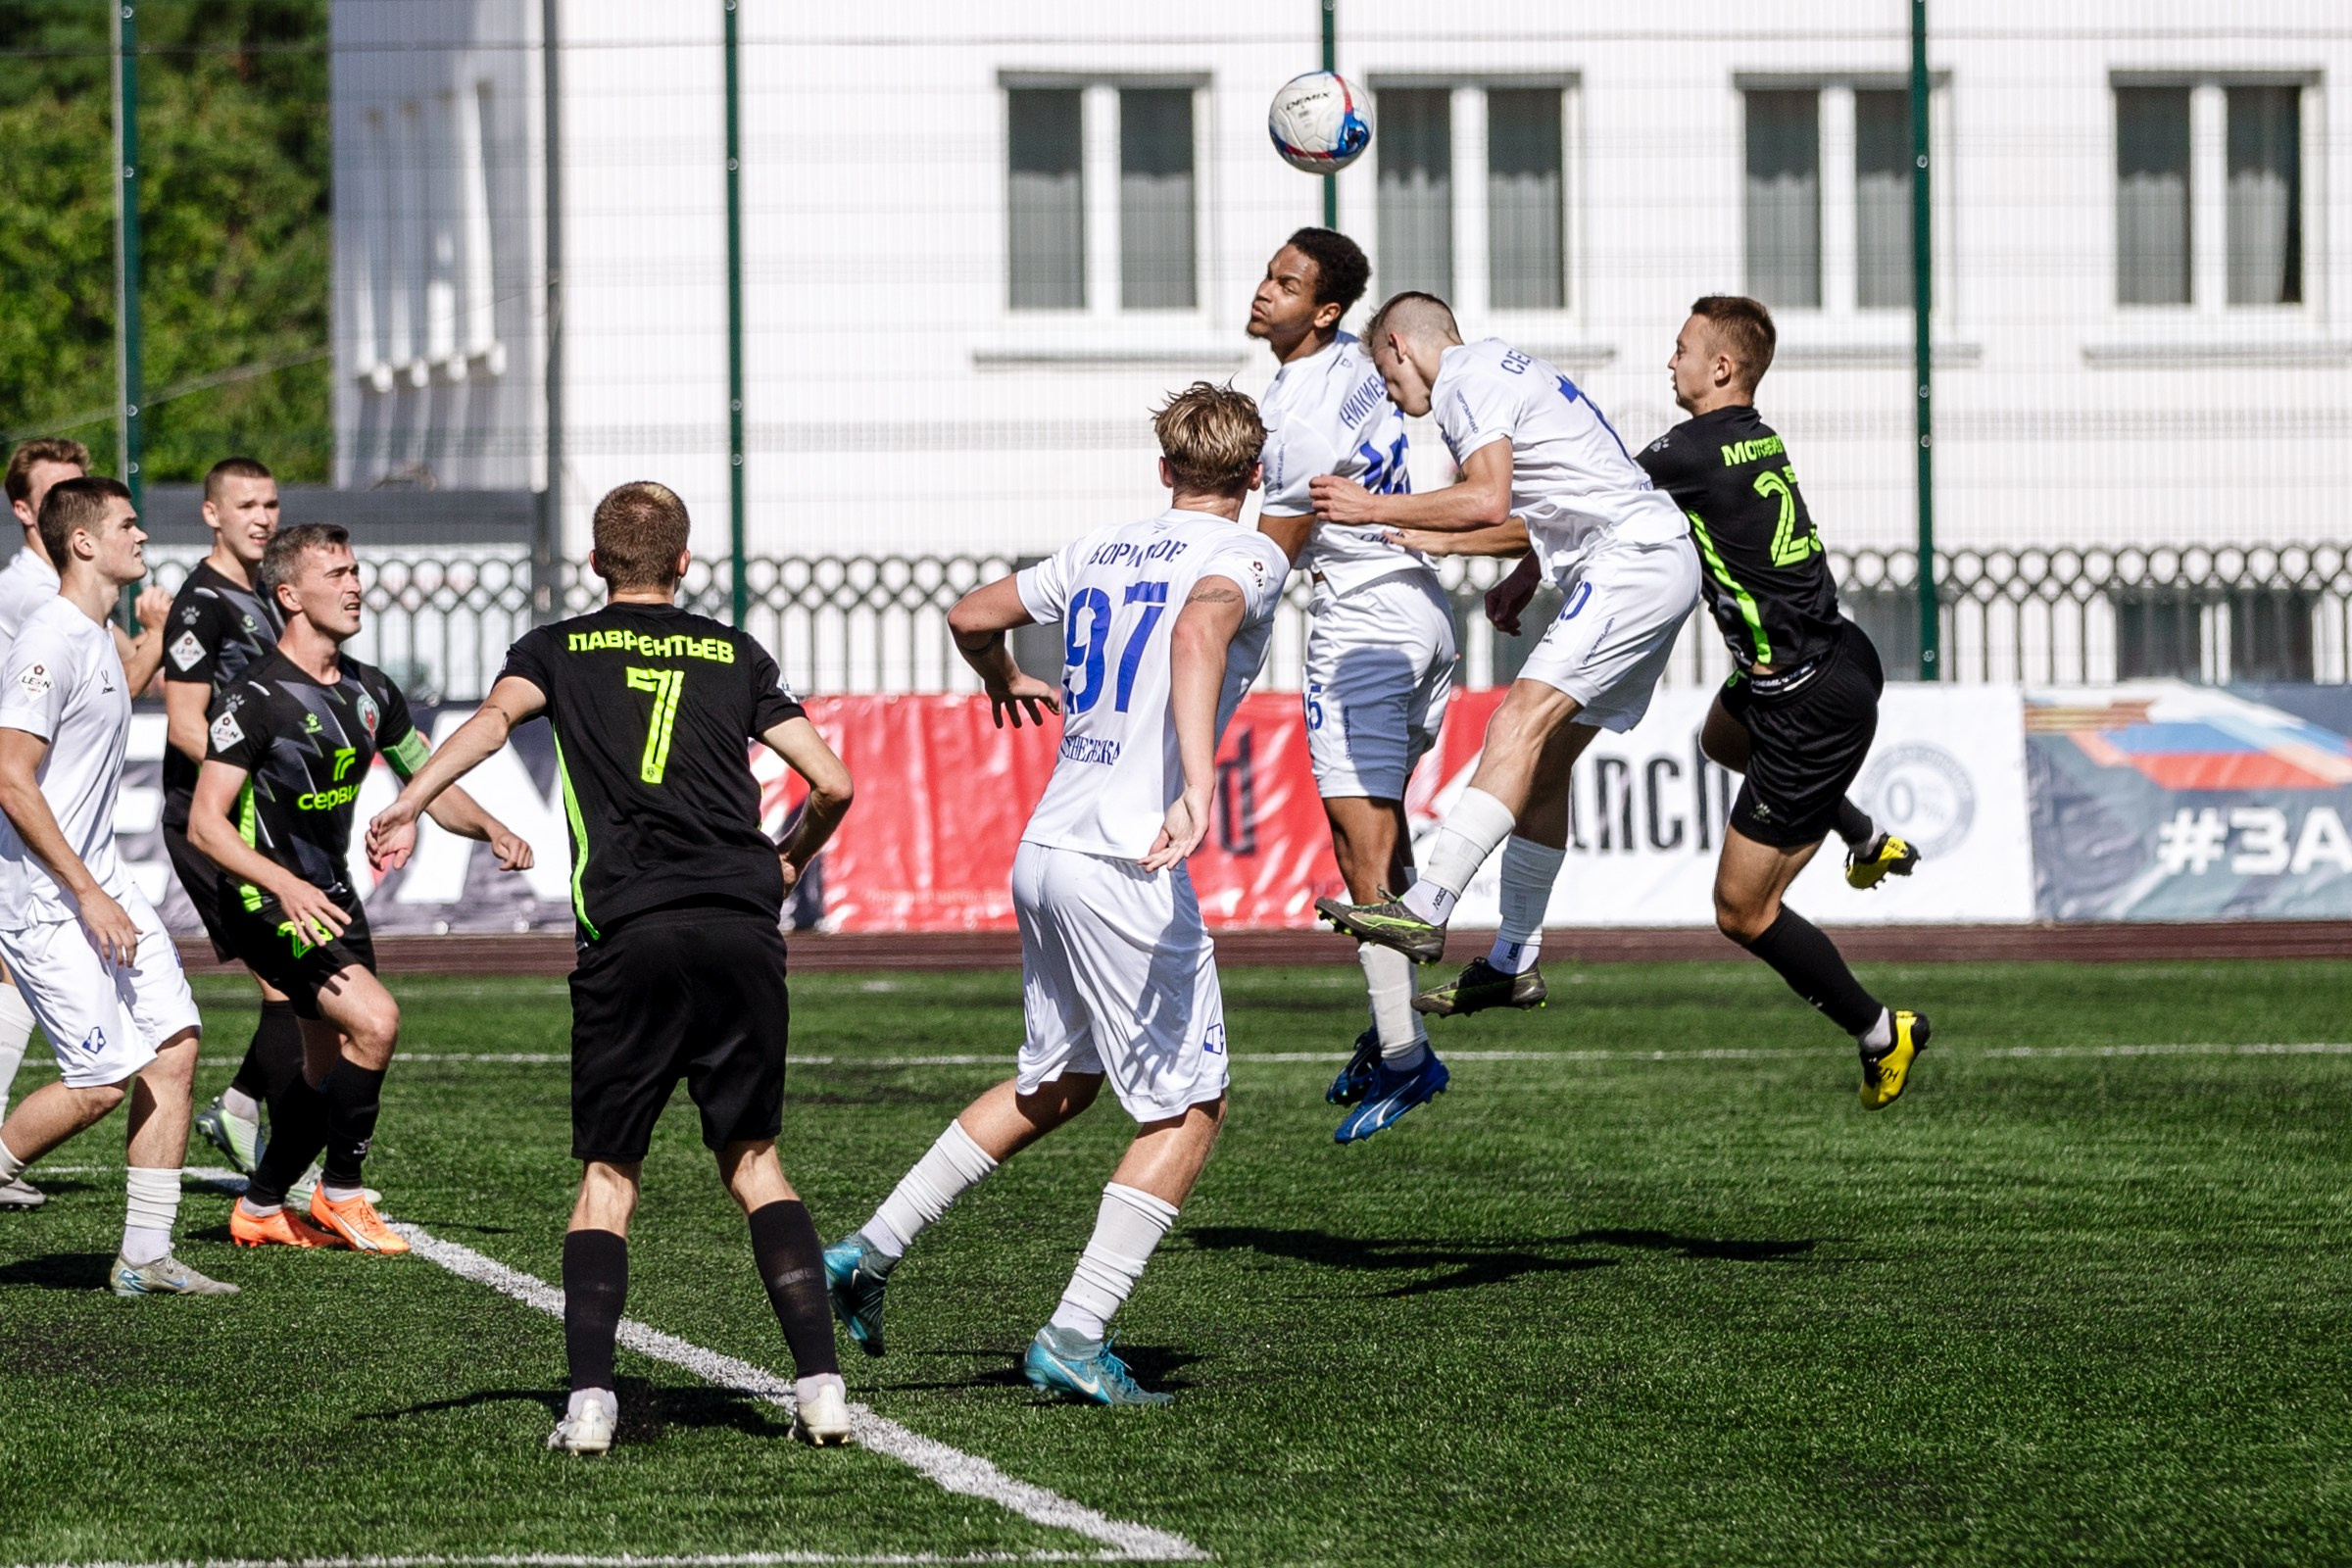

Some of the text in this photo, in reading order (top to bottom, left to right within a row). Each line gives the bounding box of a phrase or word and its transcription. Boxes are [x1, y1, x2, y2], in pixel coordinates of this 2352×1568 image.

[567, 630, 735, 663] ЛАВРЕНТЬЕВ
[1062, 580, 1169, 715] 97
[625, 665, 685, 784] 7
[277, 916, 334, 959] 2
